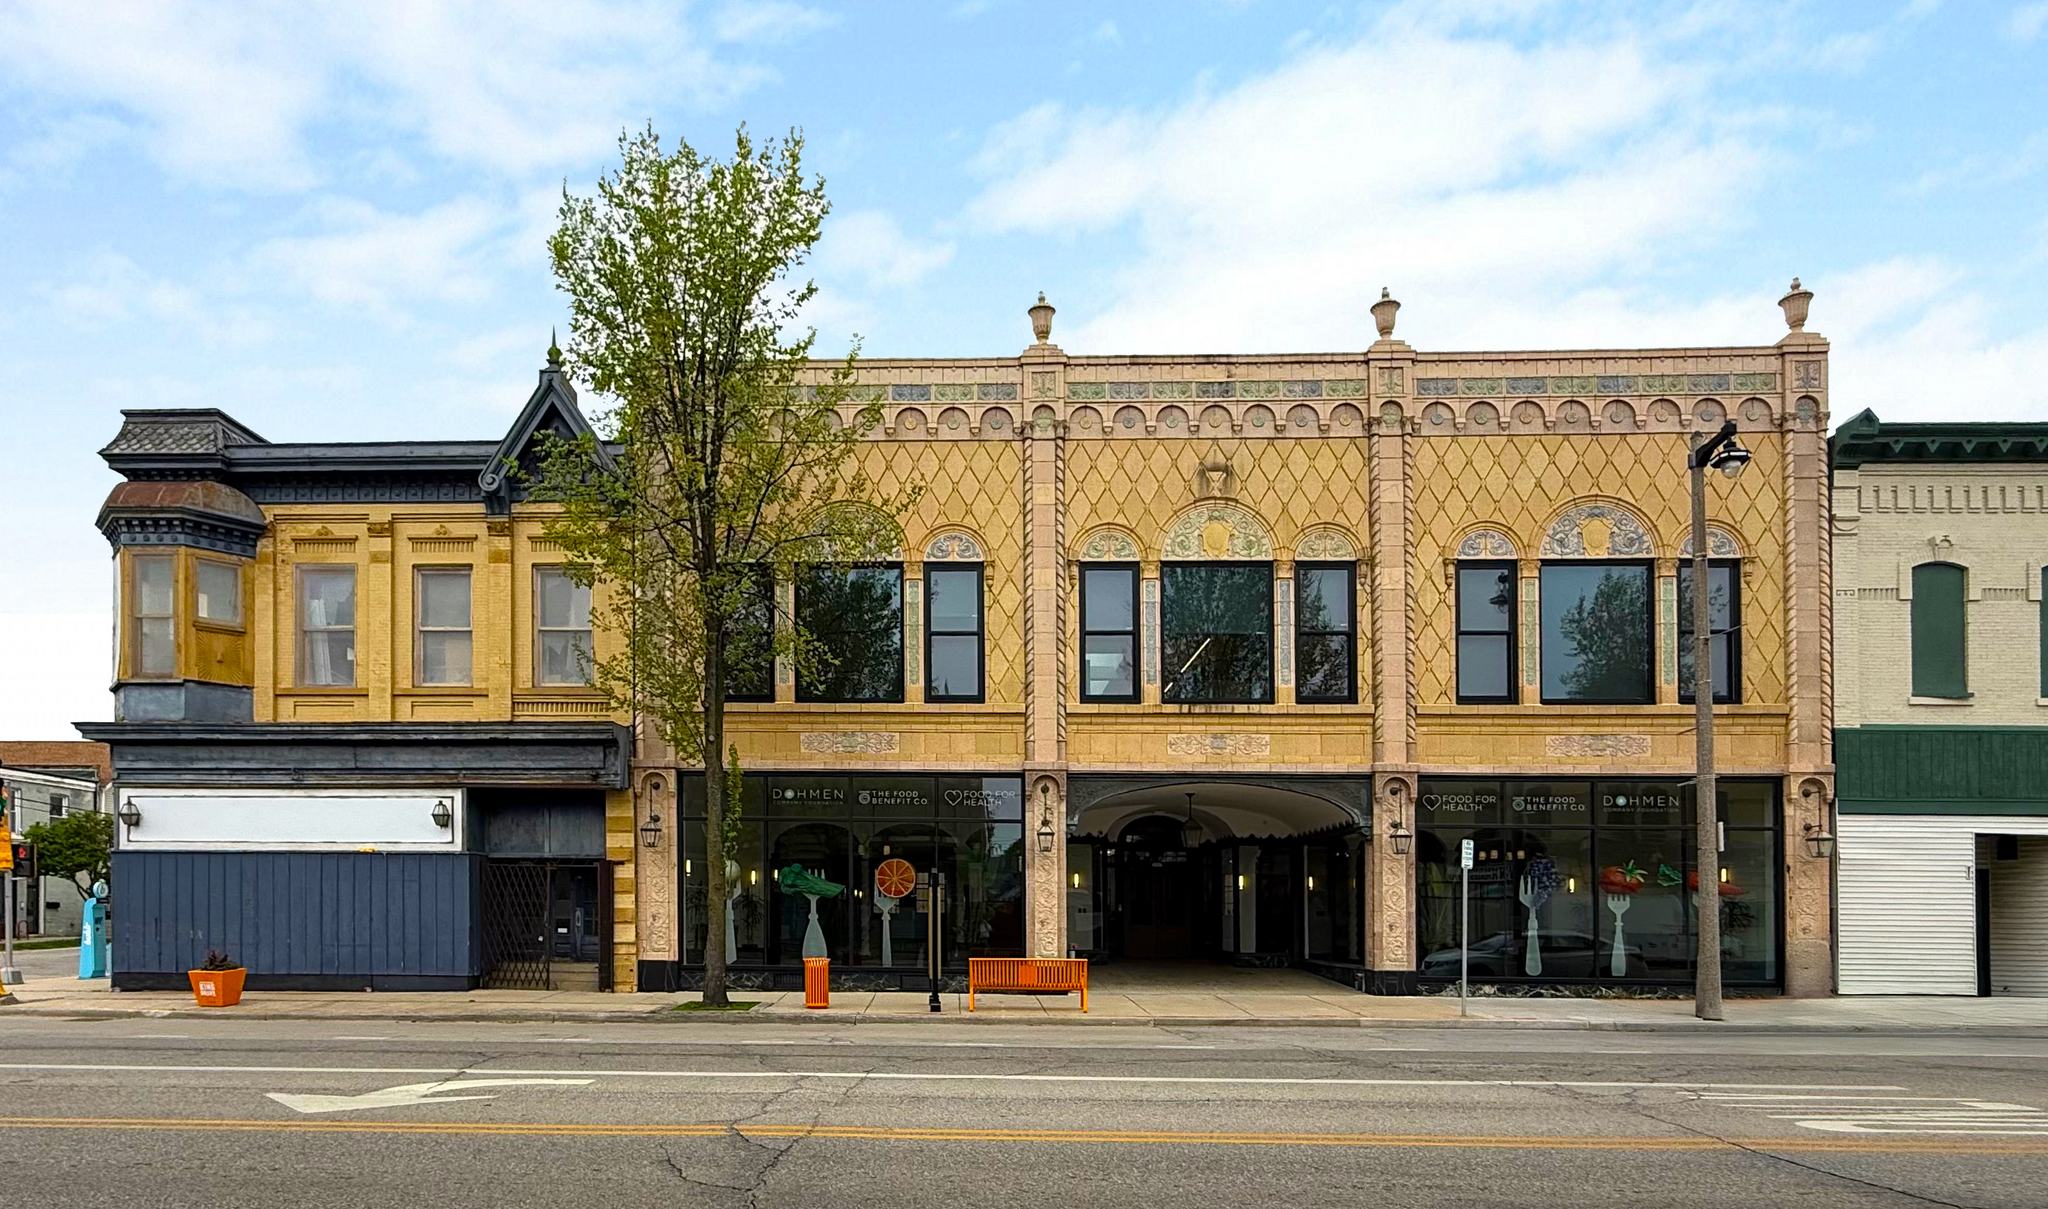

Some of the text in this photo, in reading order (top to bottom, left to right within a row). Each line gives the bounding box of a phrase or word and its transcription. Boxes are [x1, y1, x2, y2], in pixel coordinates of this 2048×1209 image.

[772, 788, 844, 800] DOHMEN
[871, 790, 919, 798] THE FOOD
[963, 790, 1016, 799] FOOD FOR
[871, 797, 911, 805] BENEFIT
[963, 798, 1002, 807] HEALTH
[1442, 795, 1497, 804] FOOD FOR
[1526, 796, 1576, 804] THE FOOD
[1603, 795, 1680, 807] DOHMEN
[1442, 803, 1482, 812] HEALTH
[1526, 803, 1568, 811] BENEFIT
